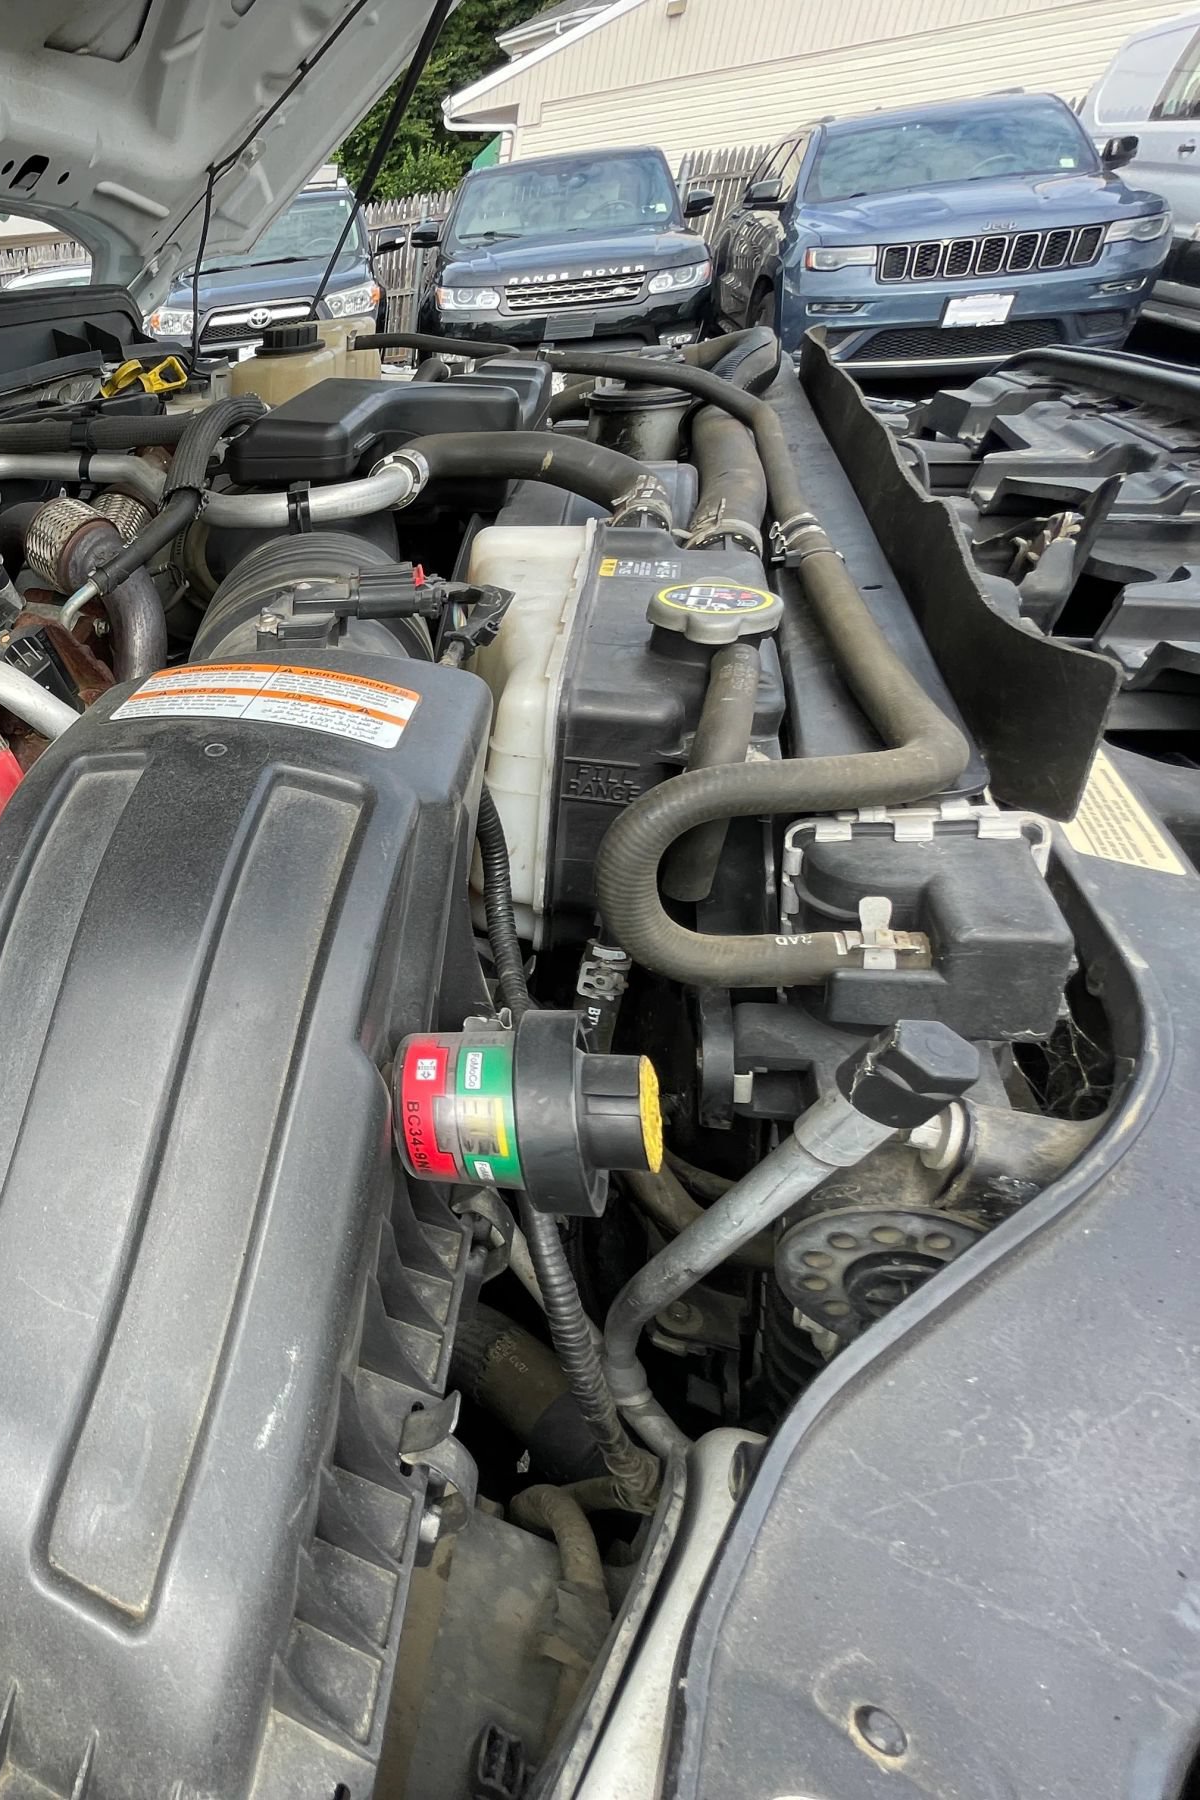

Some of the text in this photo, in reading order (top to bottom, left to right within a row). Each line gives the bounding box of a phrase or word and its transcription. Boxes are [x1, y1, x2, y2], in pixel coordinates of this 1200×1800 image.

[982, 220, 1018, 231] Jeep
[508, 264, 645, 285] RANGE ROVER
[301, 669, 390, 690] AVERTISSEMENT
[576, 764, 634, 785] FILL
[568, 778, 641, 802] RANGE
[467, 1052, 481, 1089] FoMoCo
